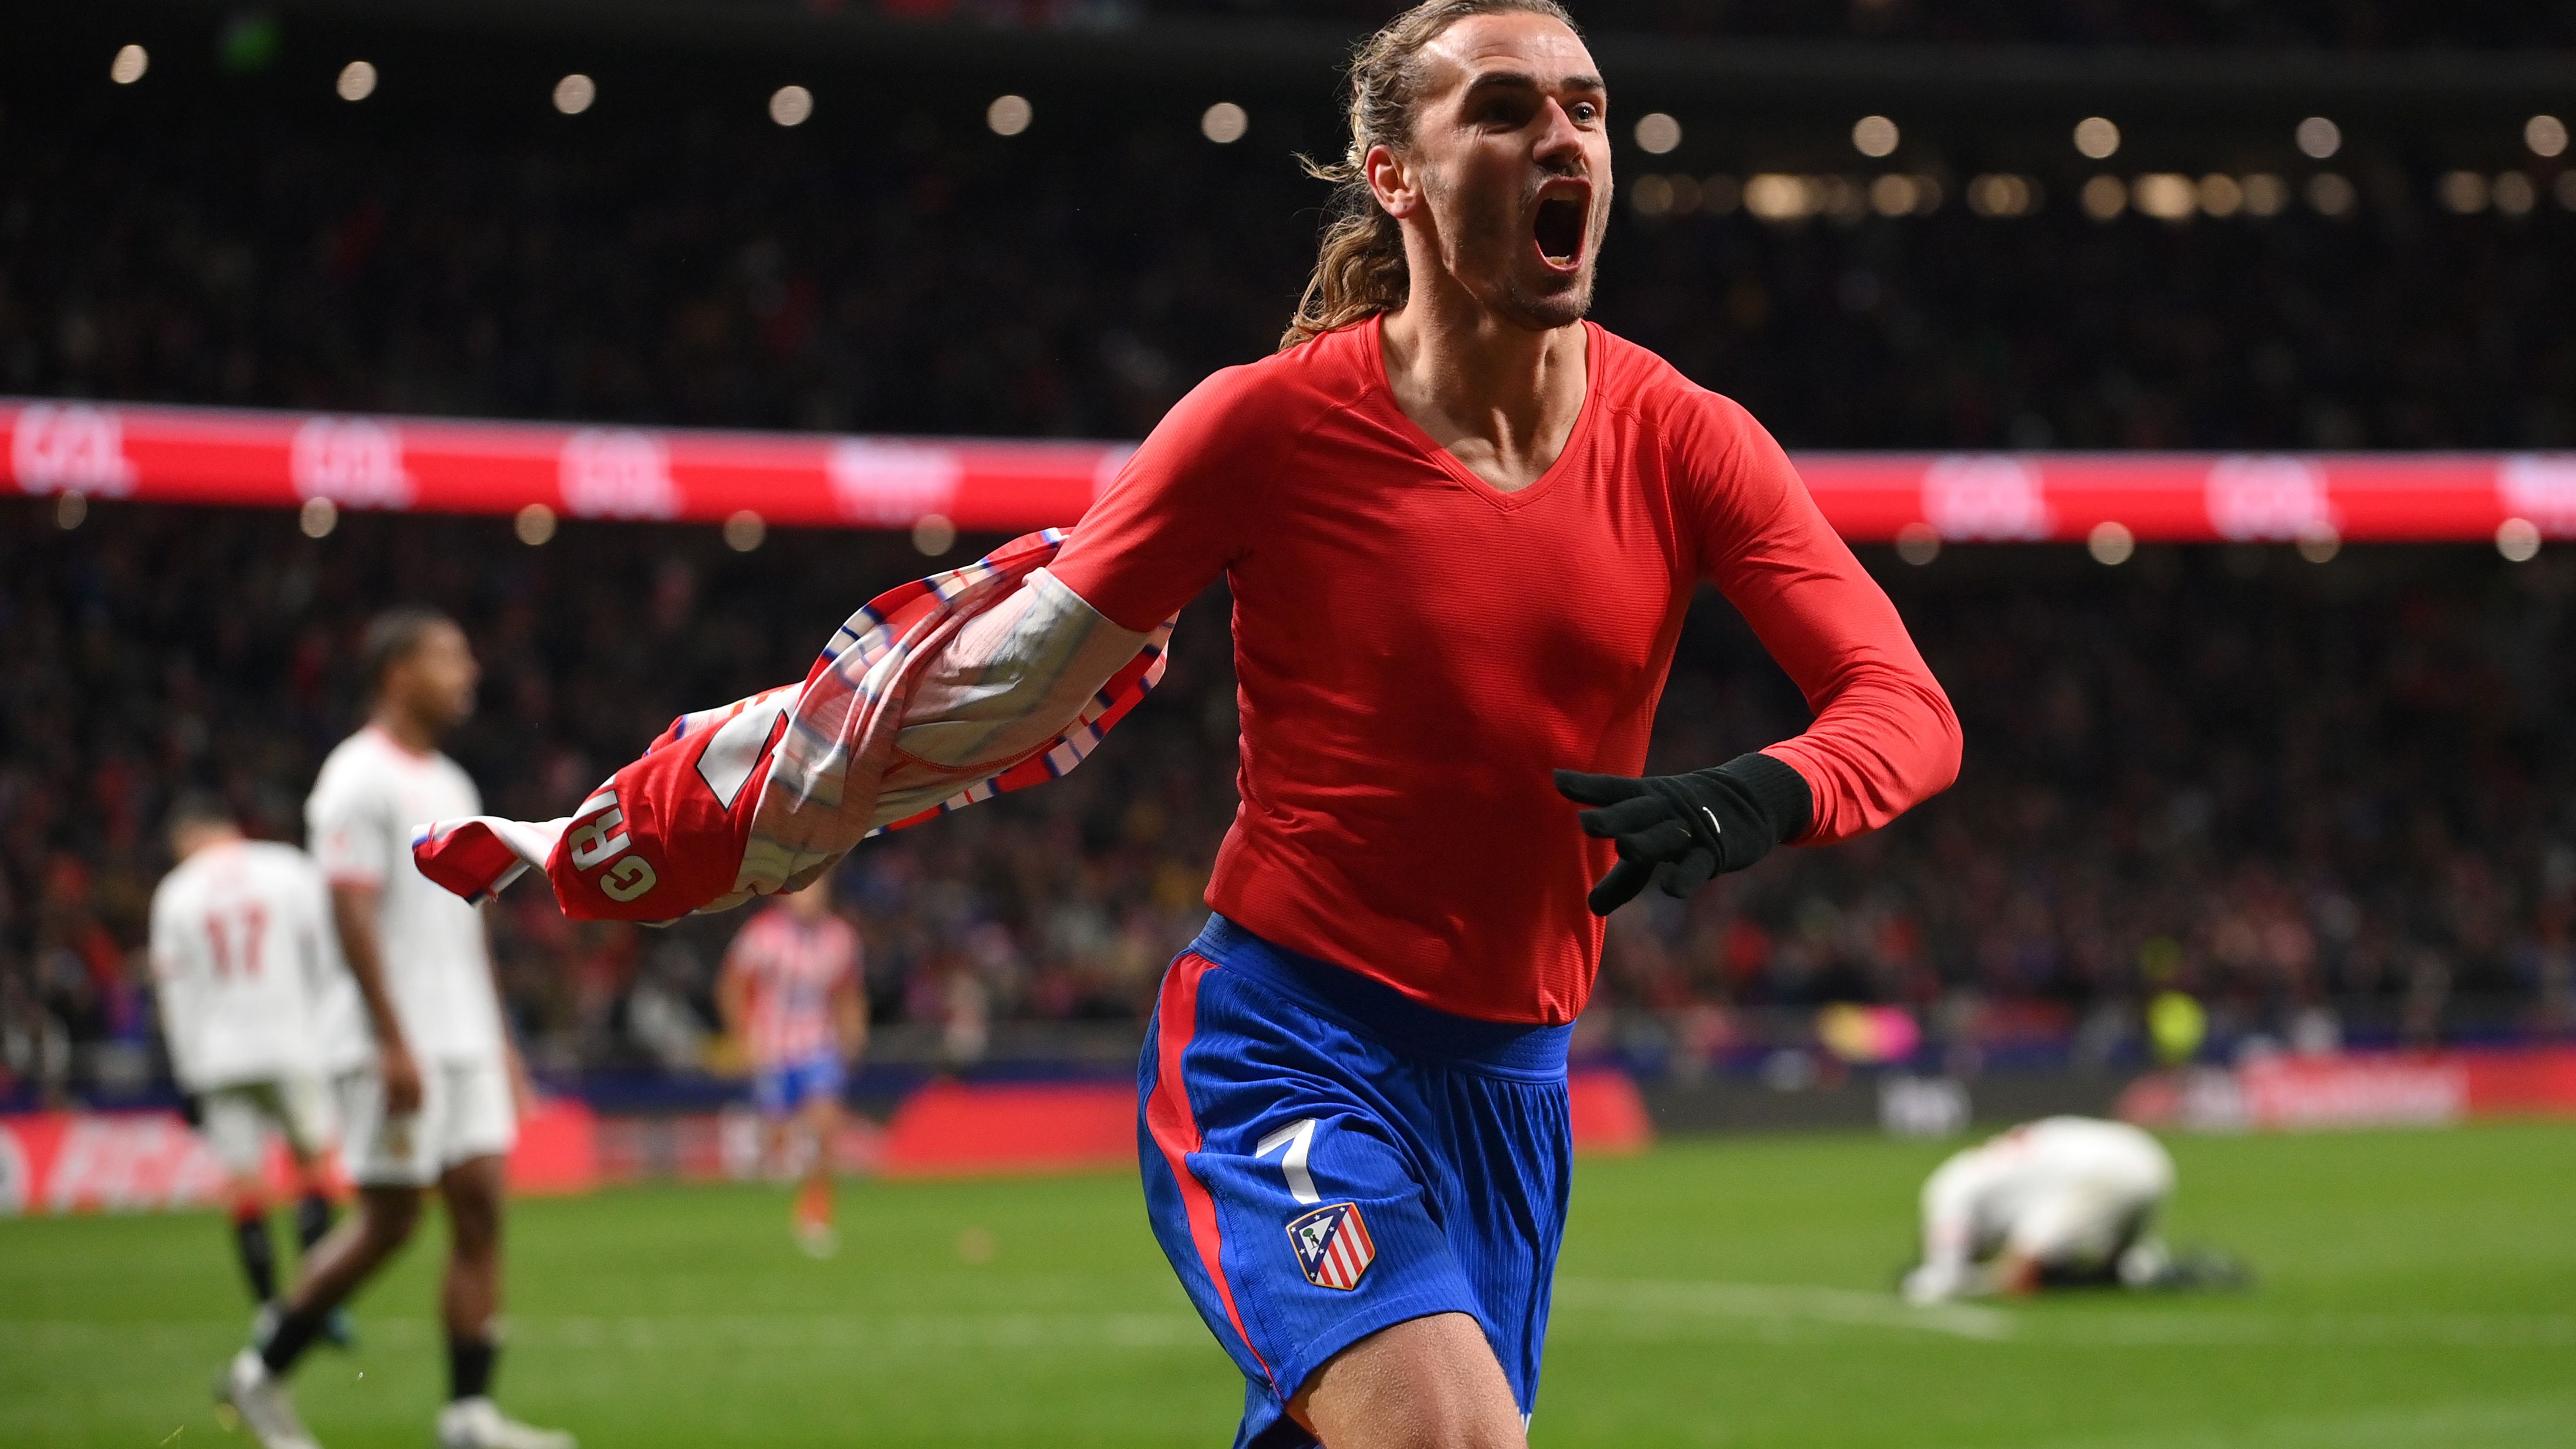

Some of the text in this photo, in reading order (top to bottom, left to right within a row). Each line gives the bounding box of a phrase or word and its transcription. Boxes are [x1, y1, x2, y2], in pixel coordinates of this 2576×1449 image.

[13, 403, 139, 498] GOL
[292, 416, 418, 509] GOL
[568, 774, 657, 902] GRI
[205, 901, 268, 978] 17
[1255, 1117, 1322, 1205] 7
